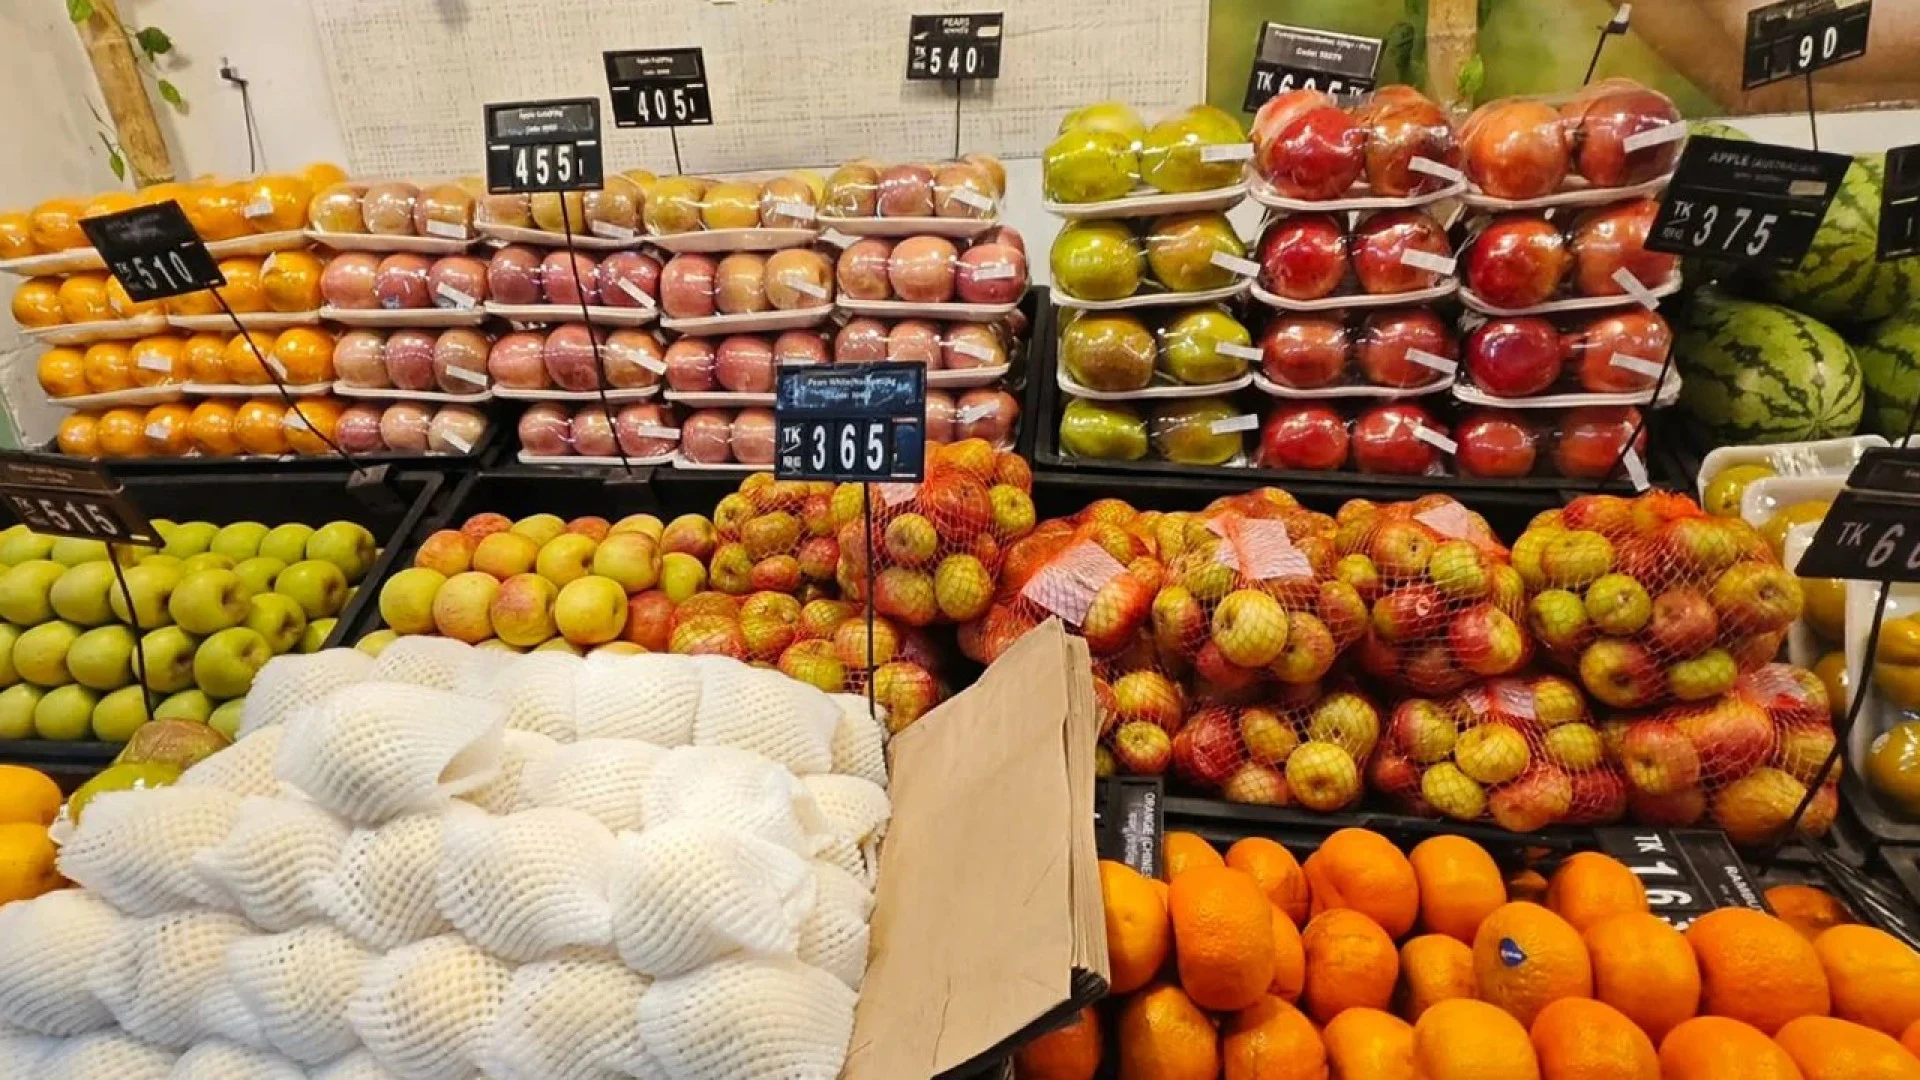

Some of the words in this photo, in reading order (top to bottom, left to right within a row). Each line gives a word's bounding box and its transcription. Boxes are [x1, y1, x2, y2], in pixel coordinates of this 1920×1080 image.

[930, 46, 977, 74] 540
[1798, 26, 1837, 68] 90
[1257, 71, 1274, 91] TK
[638, 89, 687, 123] 405
[515, 145, 571, 184] 455
[1709, 152, 1750, 168] APPLE
[1674, 200, 1694, 218] TK
[1692, 205, 1778, 256] 375
[132, 251, 193, 289] 510
[782, 427, 801, 443] TK
[812, 423, 884, 472] 365
[38, 499, 118, 534] 515
[1836, 522, 1871, 546] TK
[1143, 792, 1156, 834] ORANGE
[1633, 833, 1667, 852] TK
